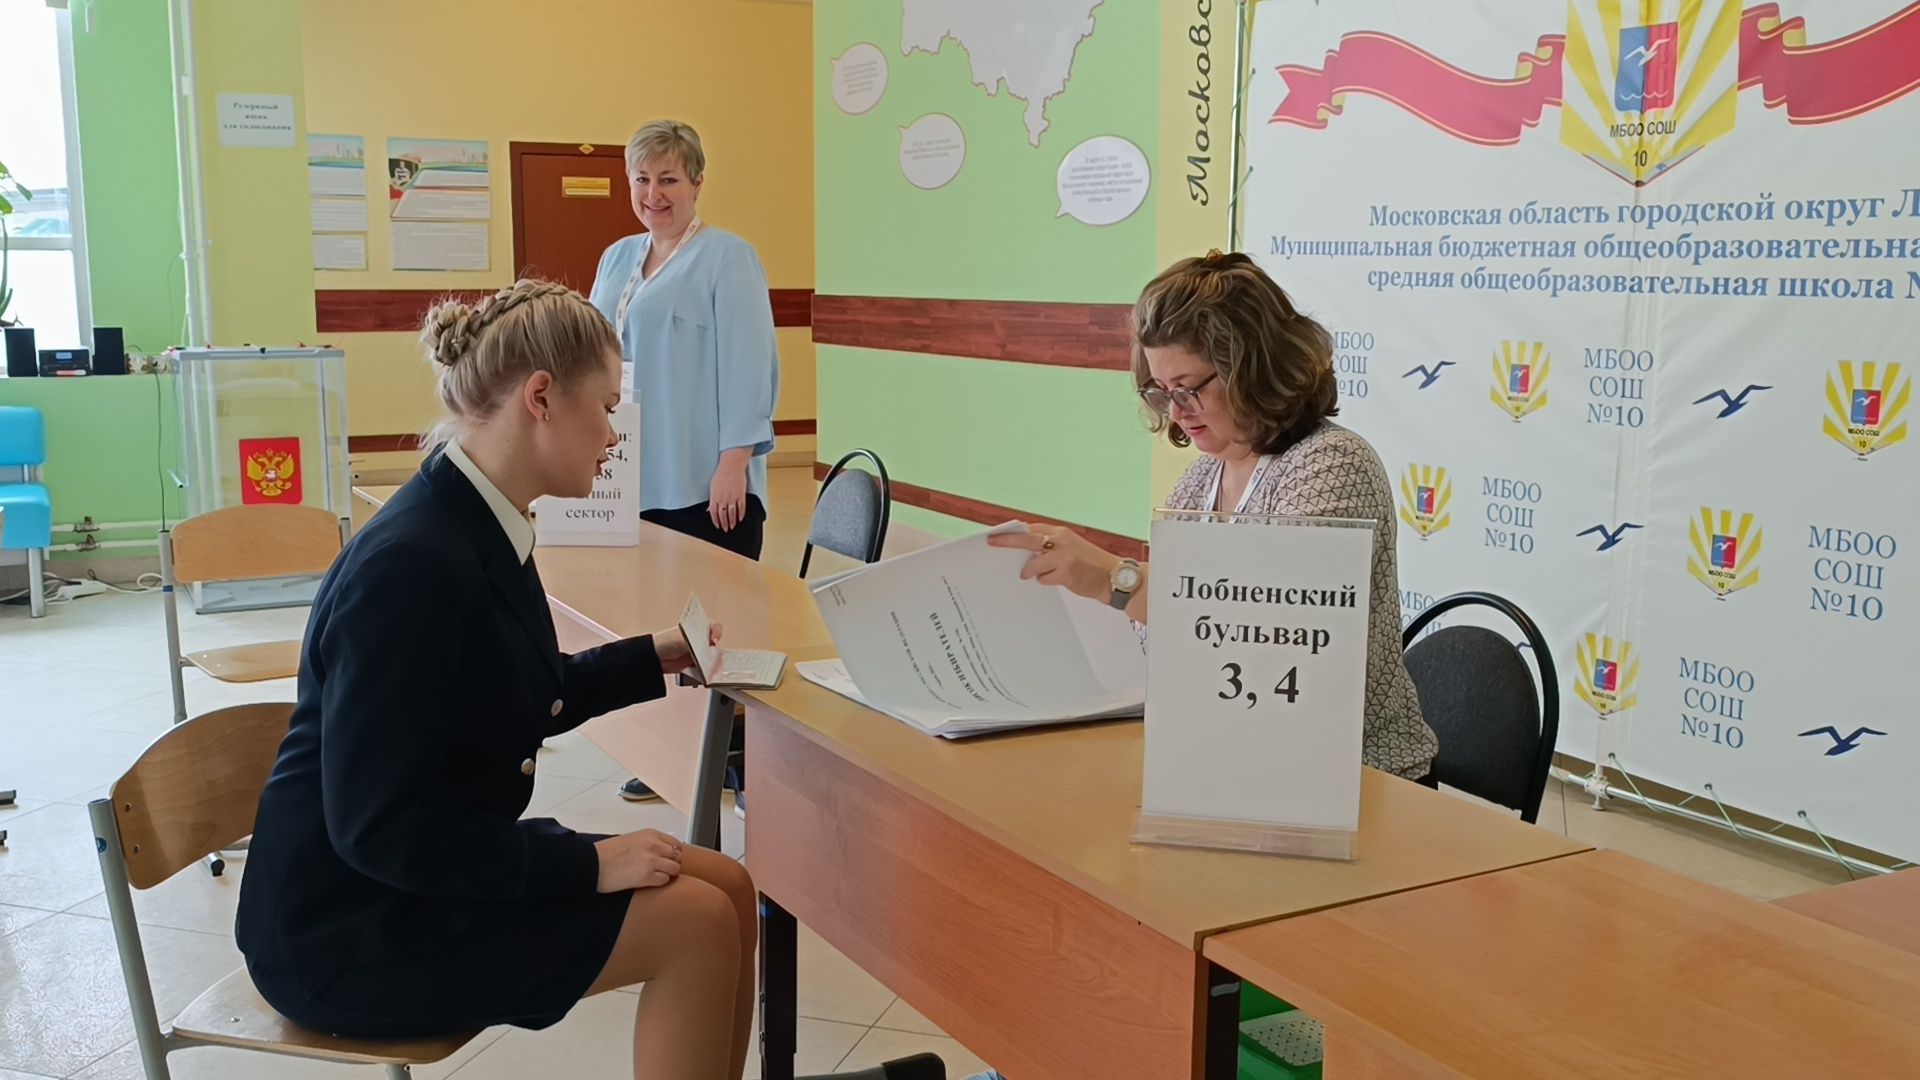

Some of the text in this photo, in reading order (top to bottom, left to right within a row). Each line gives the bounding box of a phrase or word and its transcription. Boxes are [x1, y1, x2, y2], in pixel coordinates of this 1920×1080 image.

[1610, 120, 1677, 138] МБОО СОШ
[1634, 150, 1648, 167] 10
[1369, 203, 1501, 227] Московская
[1509, 199, 1609, 224] область
[1616, 192, 1775, 230] городской
[1784, 197, 1885, 227] округ
[1270, 235, 1433, 260] Муниципальная
[1438, 234, 1576, 261] бюджетная
[1367, 269, 1454, 292] средняя
[1460, 266, 1768, 297] общеобразовательная
[1778, 277, 1895, 299] школа
[1335, 354, 1368, 374] ОШ
[1583, 347, 1654, 372] МБОО
[1589, 375, 1644, 400] СОШ
[1587, 402, 1644, 428] №10
[1482, 476, 1542, 503] МБОО
[565, 508, 615, 522] сектор
[1486, 502, 1534, 528] СОШ
[1484, 527, 1534, 554] №10
[1808, 525, 1896, 559] МБОО
[1814, 557, 1884, 589] СОШ
[1172, 575, 1357, 608] Лобненский
[1810, 586, 1883, 621] №10
[1194, 615, 1331, 654] бульвар
[1218, 662, 1300, 710] 3, 4
[1679, 656, 1754, 693] МБОО
[1684, 686, 1744, 720] СОШ
[1681, 712, 1744, 749] №10
